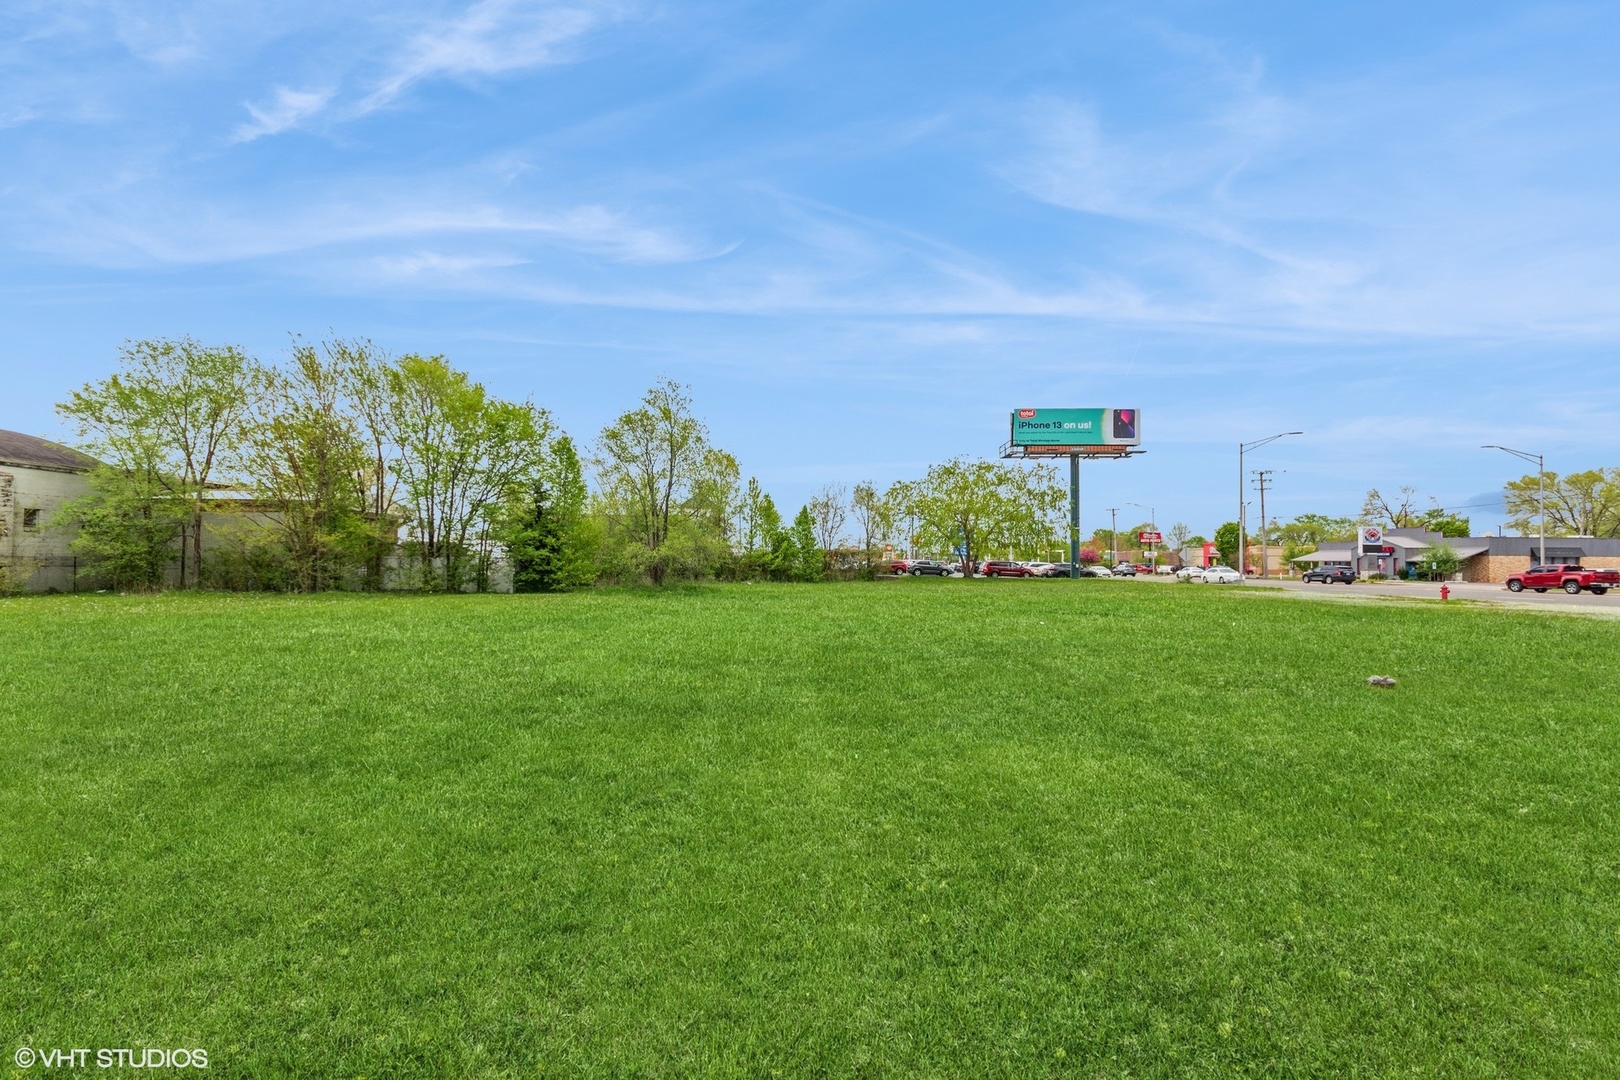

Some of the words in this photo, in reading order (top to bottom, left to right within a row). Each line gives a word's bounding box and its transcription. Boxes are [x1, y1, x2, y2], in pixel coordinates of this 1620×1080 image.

[1018, 421, 1051, 429] iPhone
[1052, 421, 1062, 429] 13
[1078, 421, 1092, 429] us!
